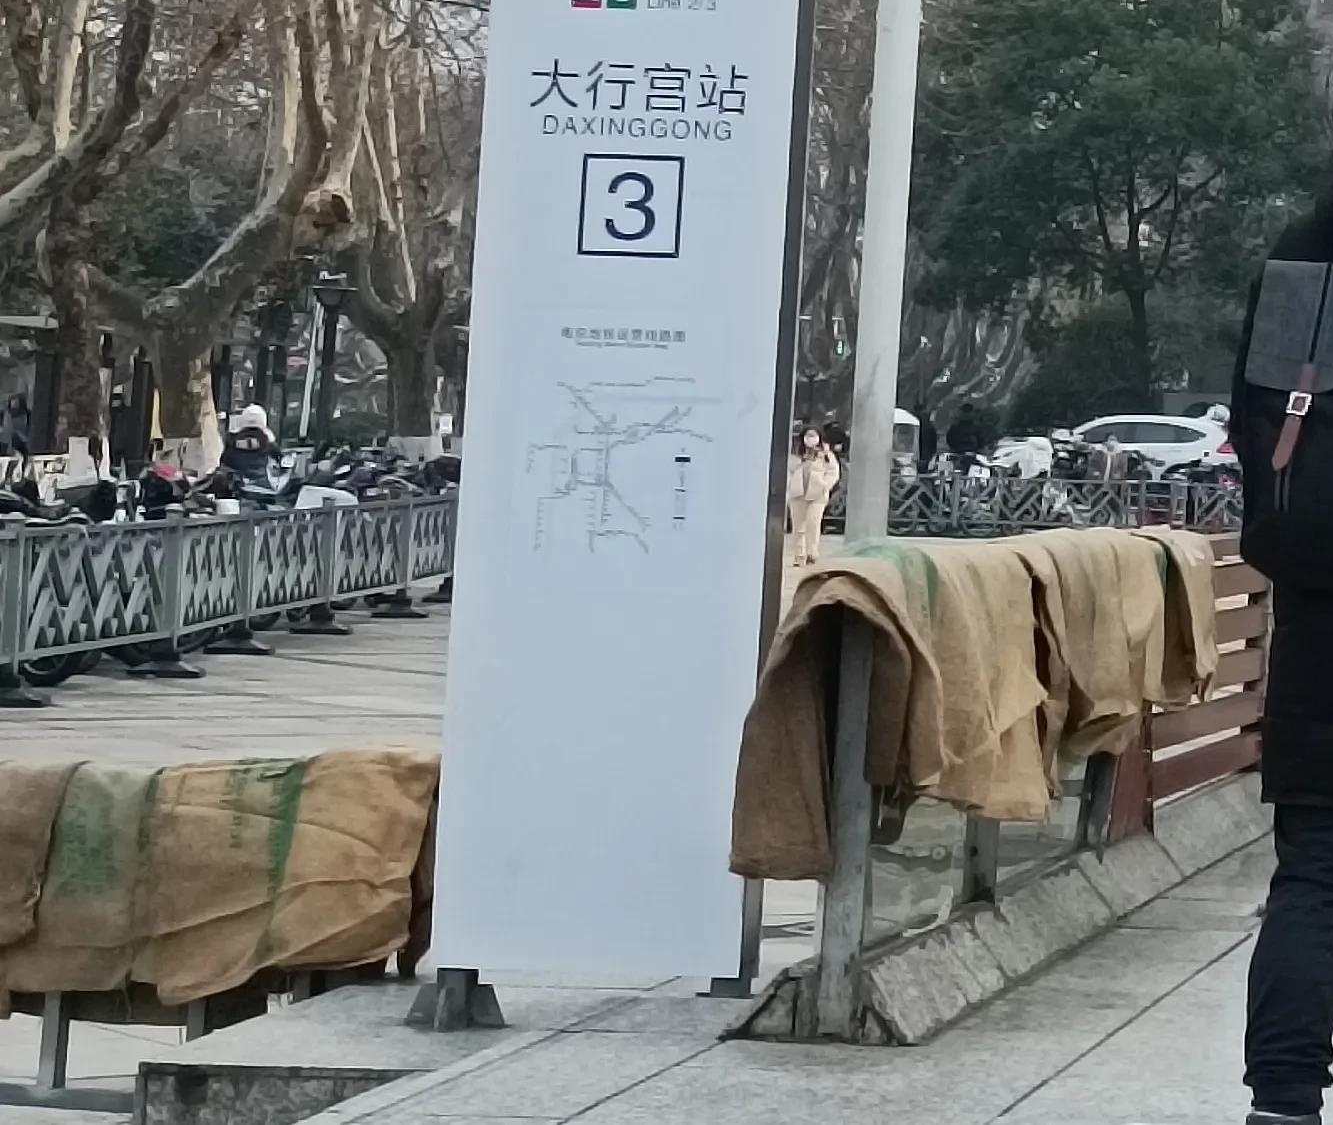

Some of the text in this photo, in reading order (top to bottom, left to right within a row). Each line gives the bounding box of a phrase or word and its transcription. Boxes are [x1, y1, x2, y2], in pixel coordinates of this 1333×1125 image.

[530, 58, 748, 116] 大行宫站
[542, 114, 733, 142] DAXINGGONG
[605, 172, 656, 242] 3
